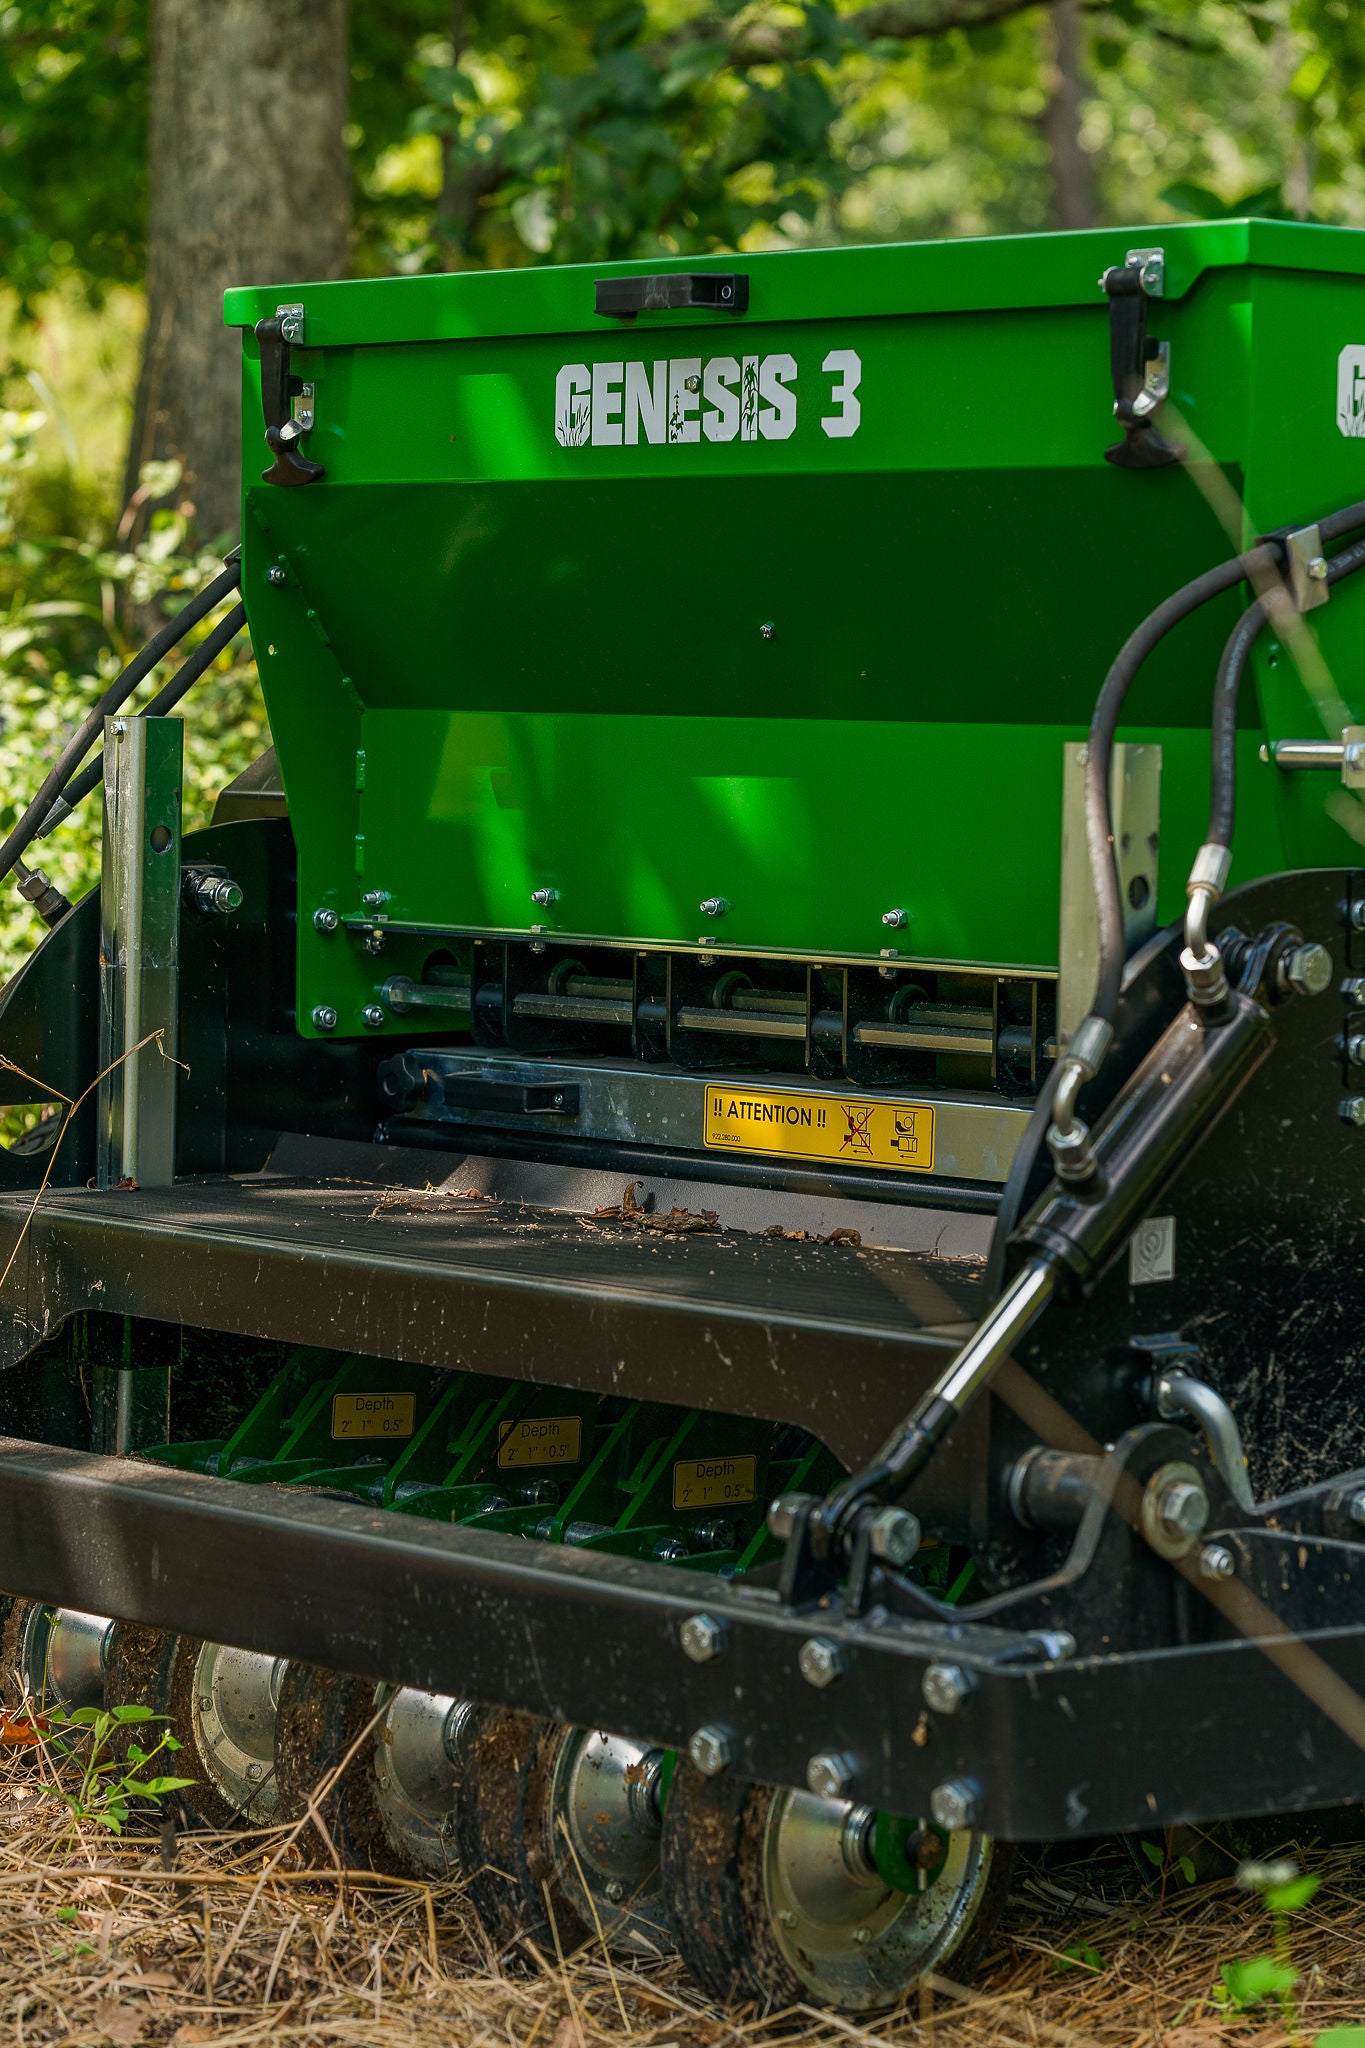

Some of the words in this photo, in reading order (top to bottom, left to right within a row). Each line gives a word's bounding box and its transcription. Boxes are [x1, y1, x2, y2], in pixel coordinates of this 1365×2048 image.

[555, 353, 798, 447] GENESIS
[821, 349, 862, 438] 3
[713, 1098, 723, 1117] !!
[727, 1100, 812, 1127] ATTENTION
[817, 1109, 826, 1128] !!
[355, 1397, 394, 1412] Depth
[521, 1422, 560, 1438] Depth
[696, 1461, 735, 1479] Depth
